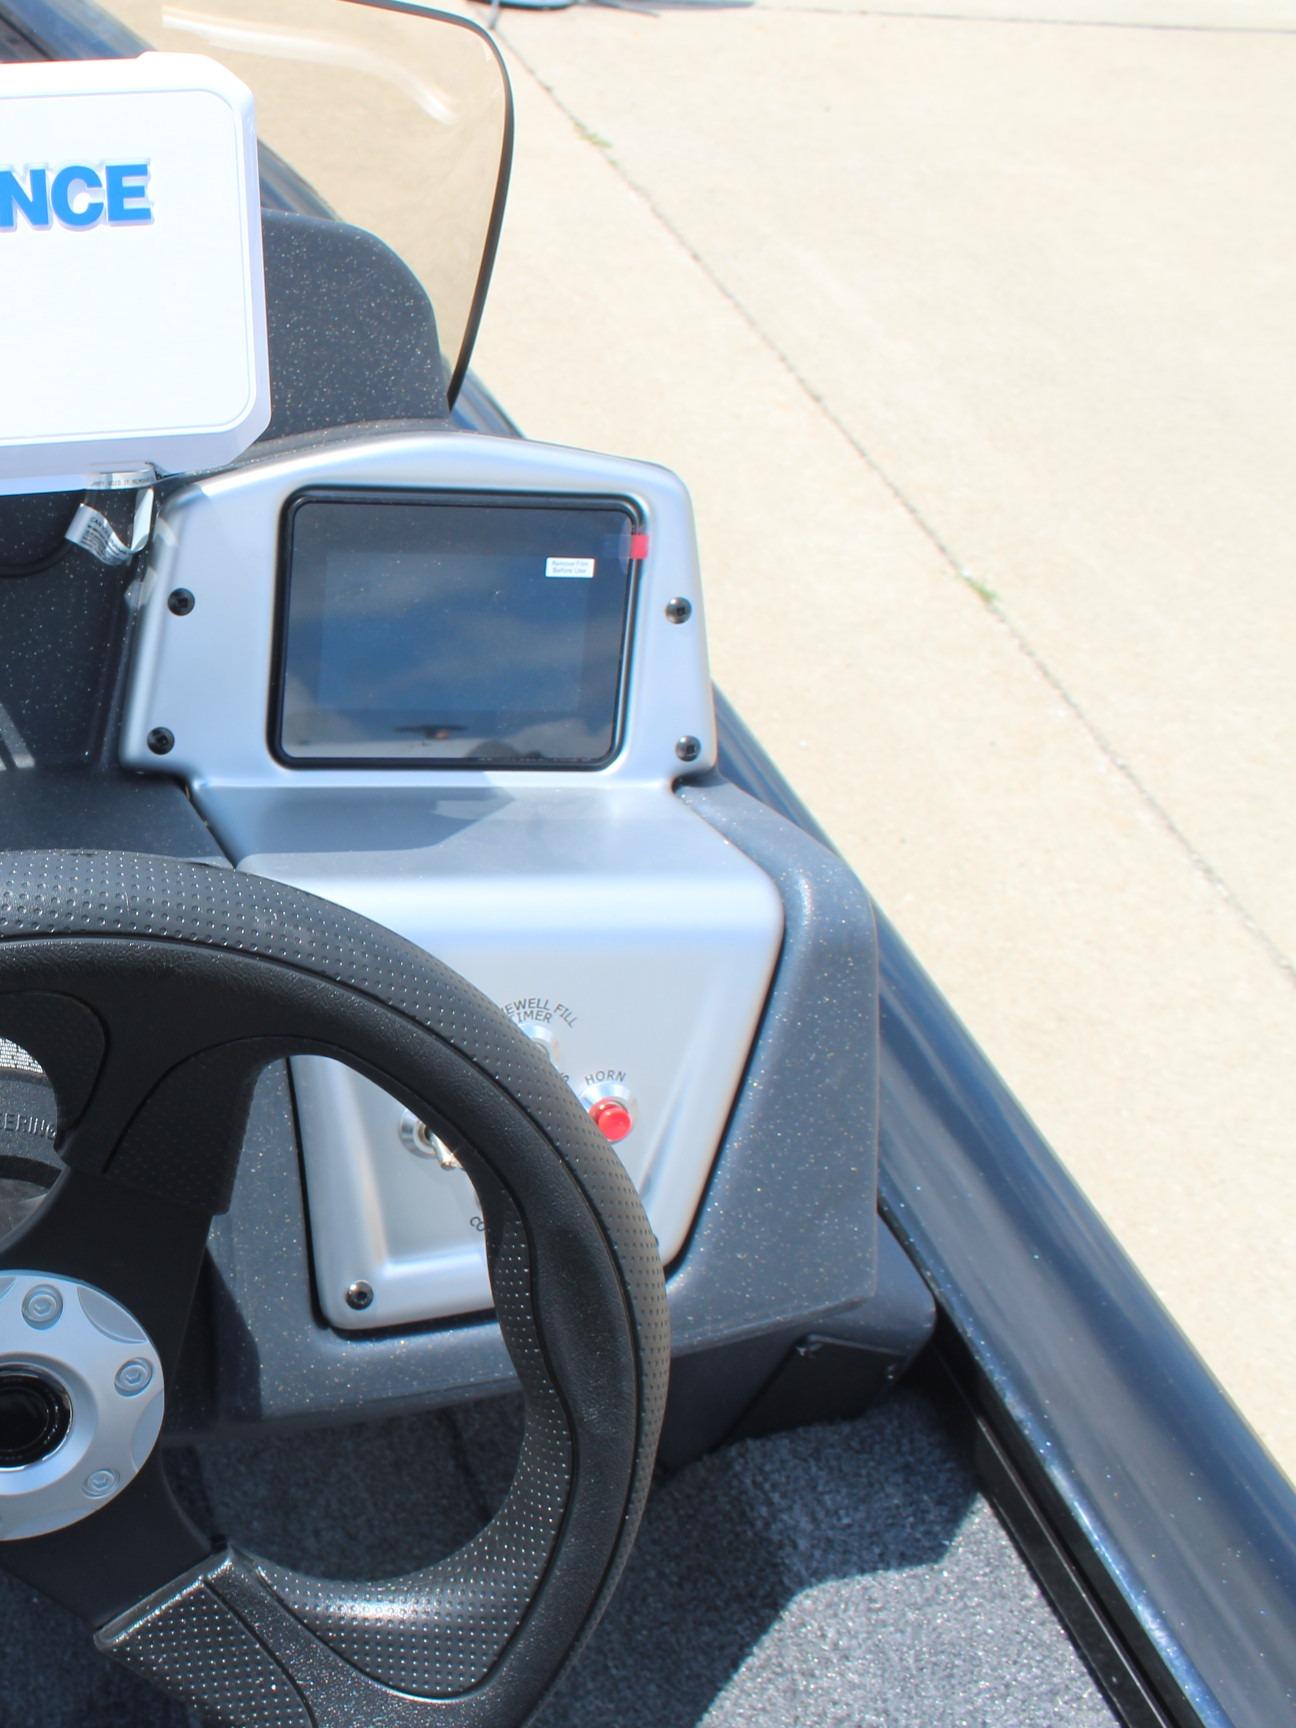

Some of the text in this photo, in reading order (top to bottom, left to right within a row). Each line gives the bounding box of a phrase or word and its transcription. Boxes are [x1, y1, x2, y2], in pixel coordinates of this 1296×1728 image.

[503, 998, 578, 1028] EWELL FILL
[585, 1069, 627, 1085] HORN
